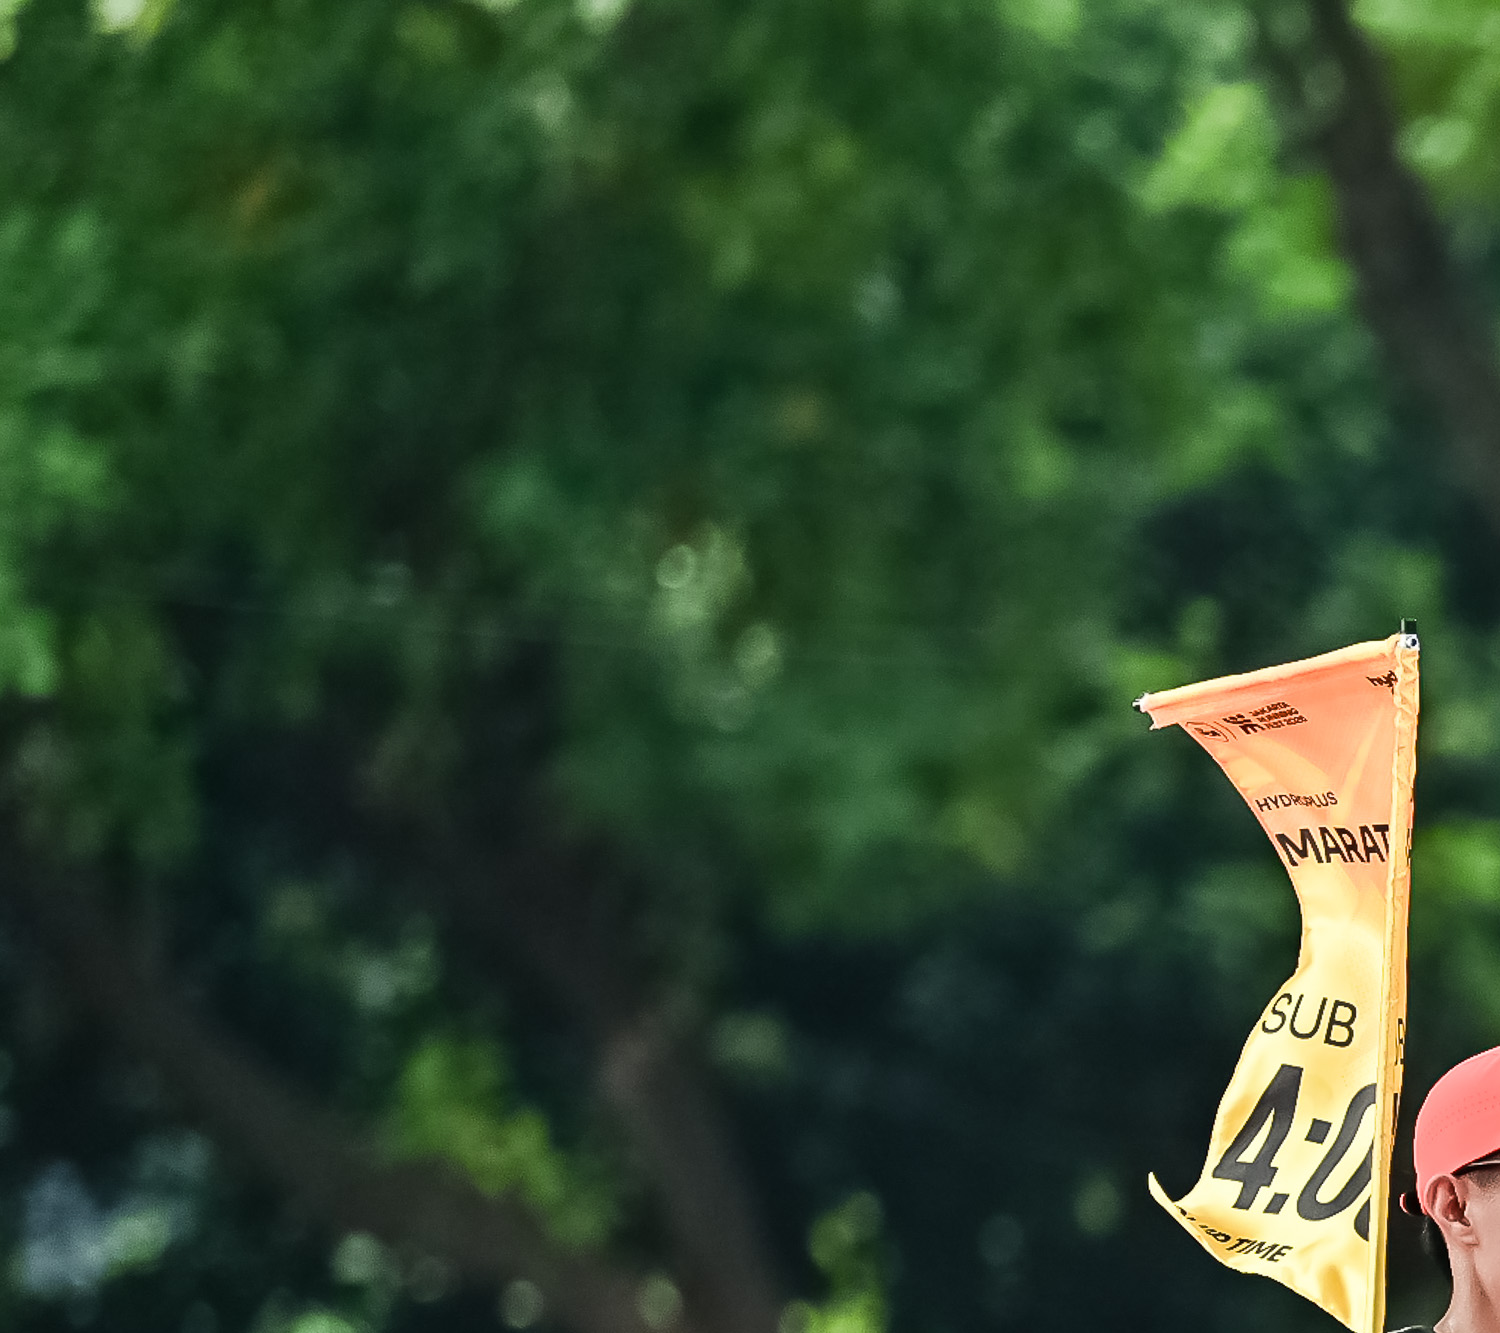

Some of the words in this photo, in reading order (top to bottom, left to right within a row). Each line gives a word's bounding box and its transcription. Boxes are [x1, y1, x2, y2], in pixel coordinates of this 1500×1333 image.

[1261, 992, 1358, 1047] SUB
[1212, 1063, 1377, 1242] 4:0
[1226, 1237, 1294, 1262] TIME
